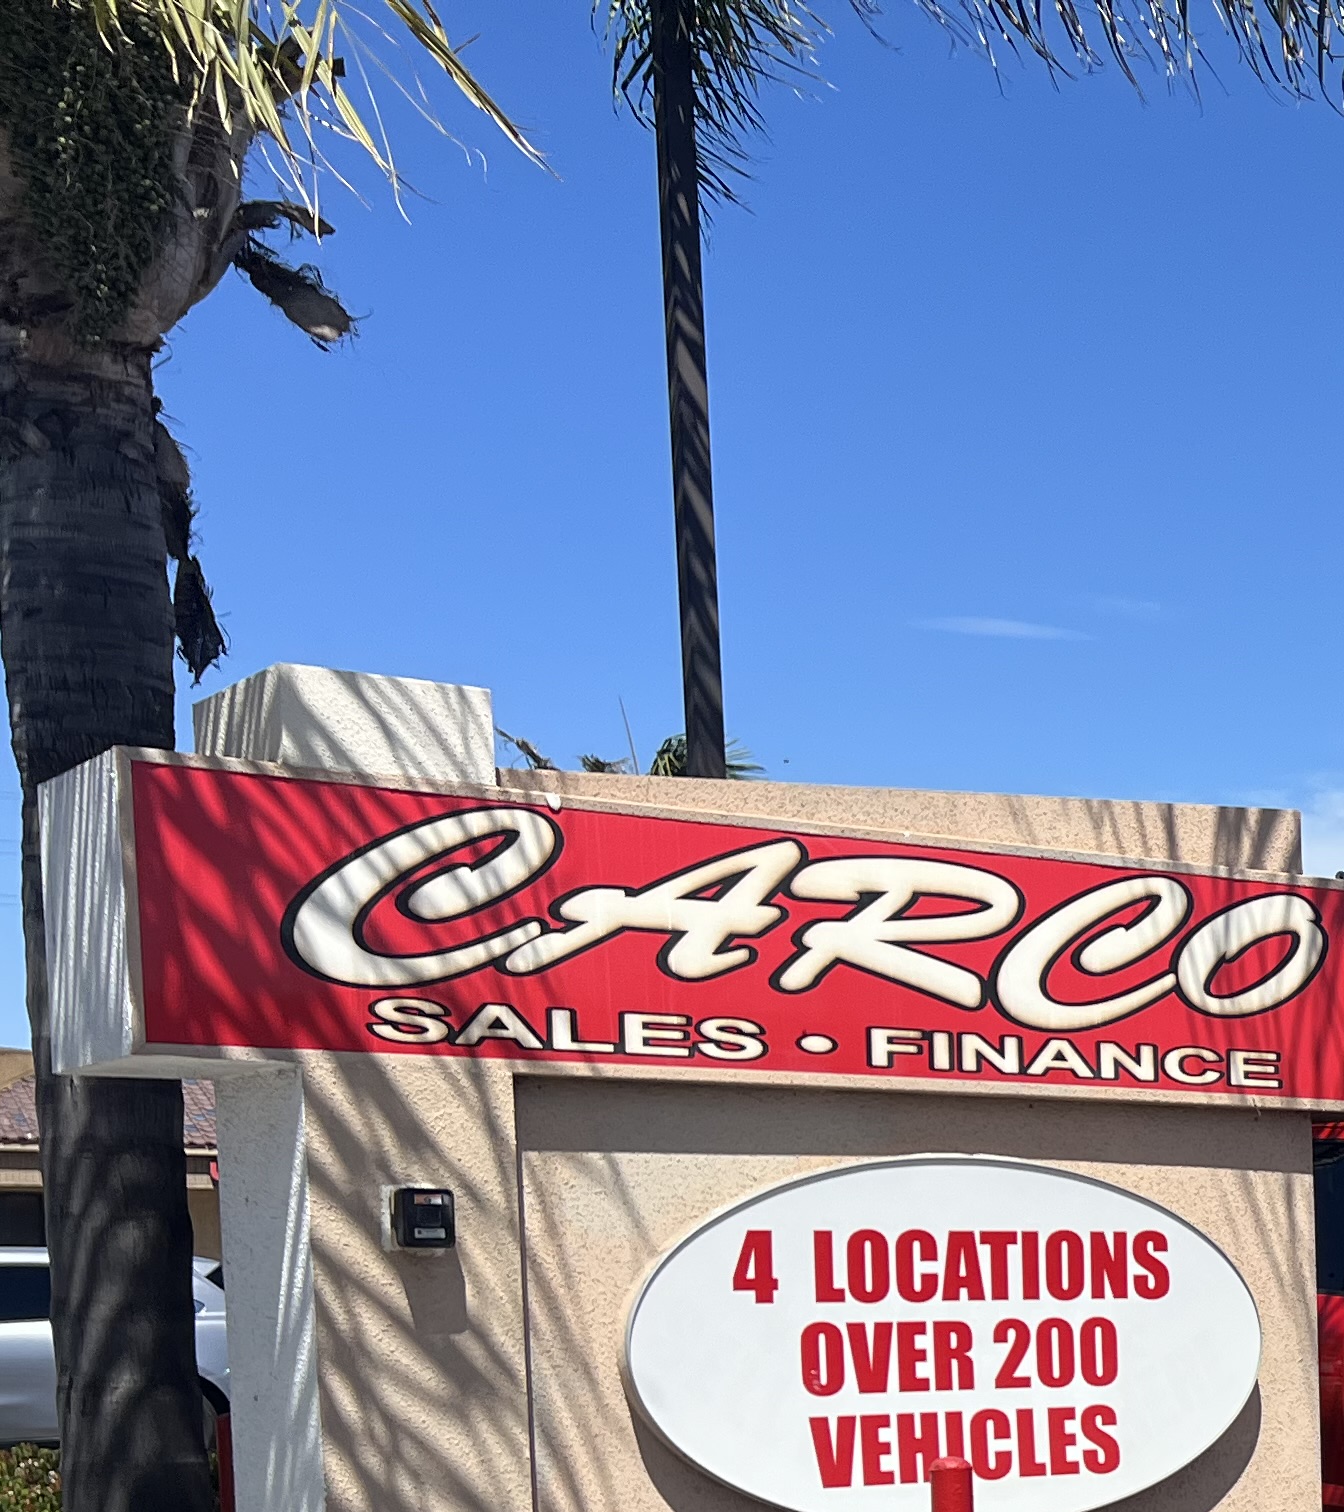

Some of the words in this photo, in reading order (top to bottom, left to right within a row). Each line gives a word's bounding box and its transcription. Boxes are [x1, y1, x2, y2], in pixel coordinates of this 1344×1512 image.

[281, 806, 1327, 1031] CARCO
[367, 997, 769, 1063] SALES
[867, 1026, 1284, 1092] FINANCE
[732, 1229, 779, 1304] 4
[812, 1229, 1171, 1304] LOCATIONS
[799, 1319, 975, 1397] OVER
[991, 1316, 1119, 1389] 200
[808, 1403, 1121, 1489] VEHICLES
